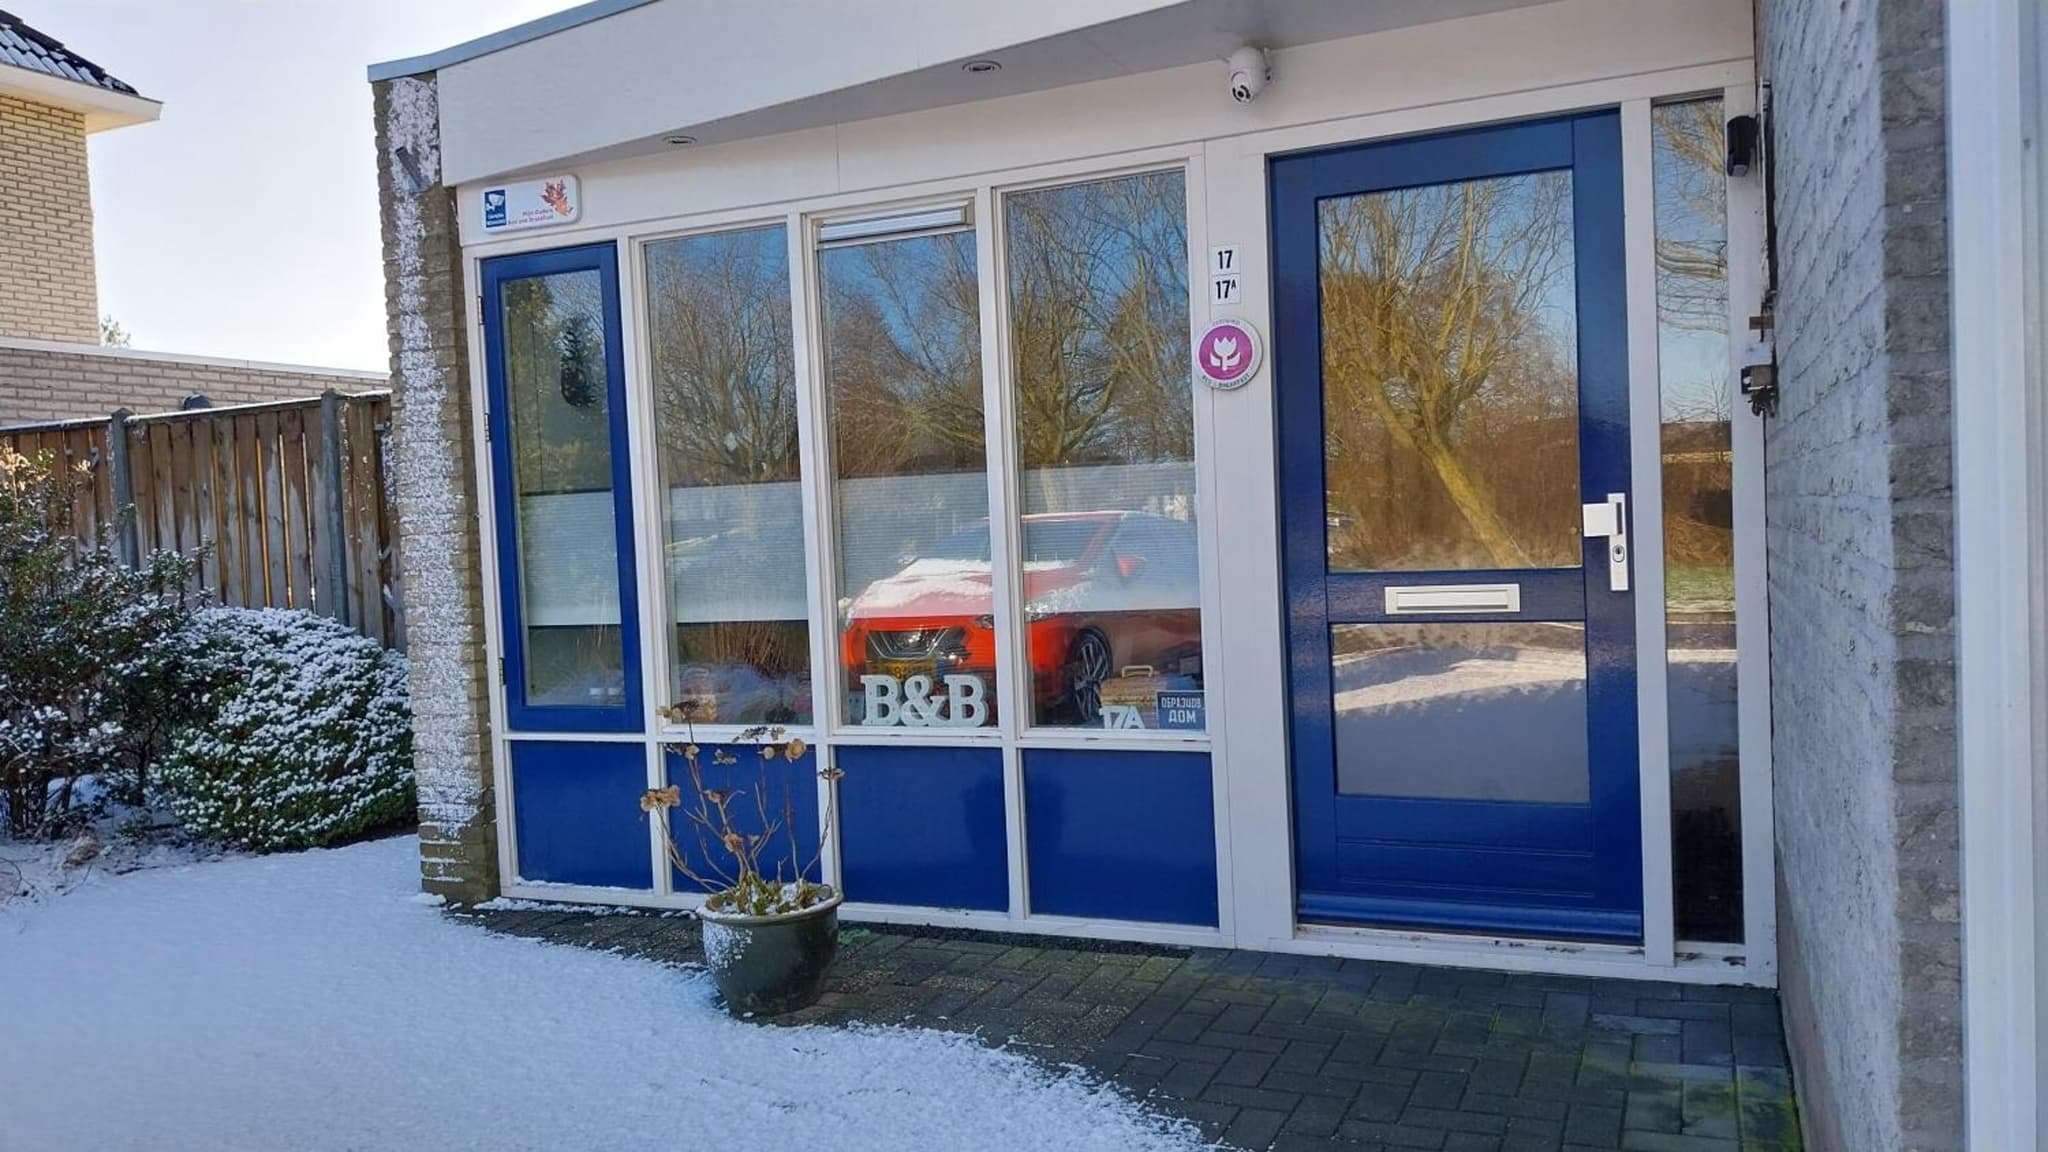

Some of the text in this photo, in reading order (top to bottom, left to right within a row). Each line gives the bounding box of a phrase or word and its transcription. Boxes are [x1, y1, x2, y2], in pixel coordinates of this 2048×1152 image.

[1217, 249, 1233, 270] 17
[859, 674, 989, 728] B&B
[1099, 704, 1146, 729] 17A
[1168, 709, 1197, 724] ДОМ
